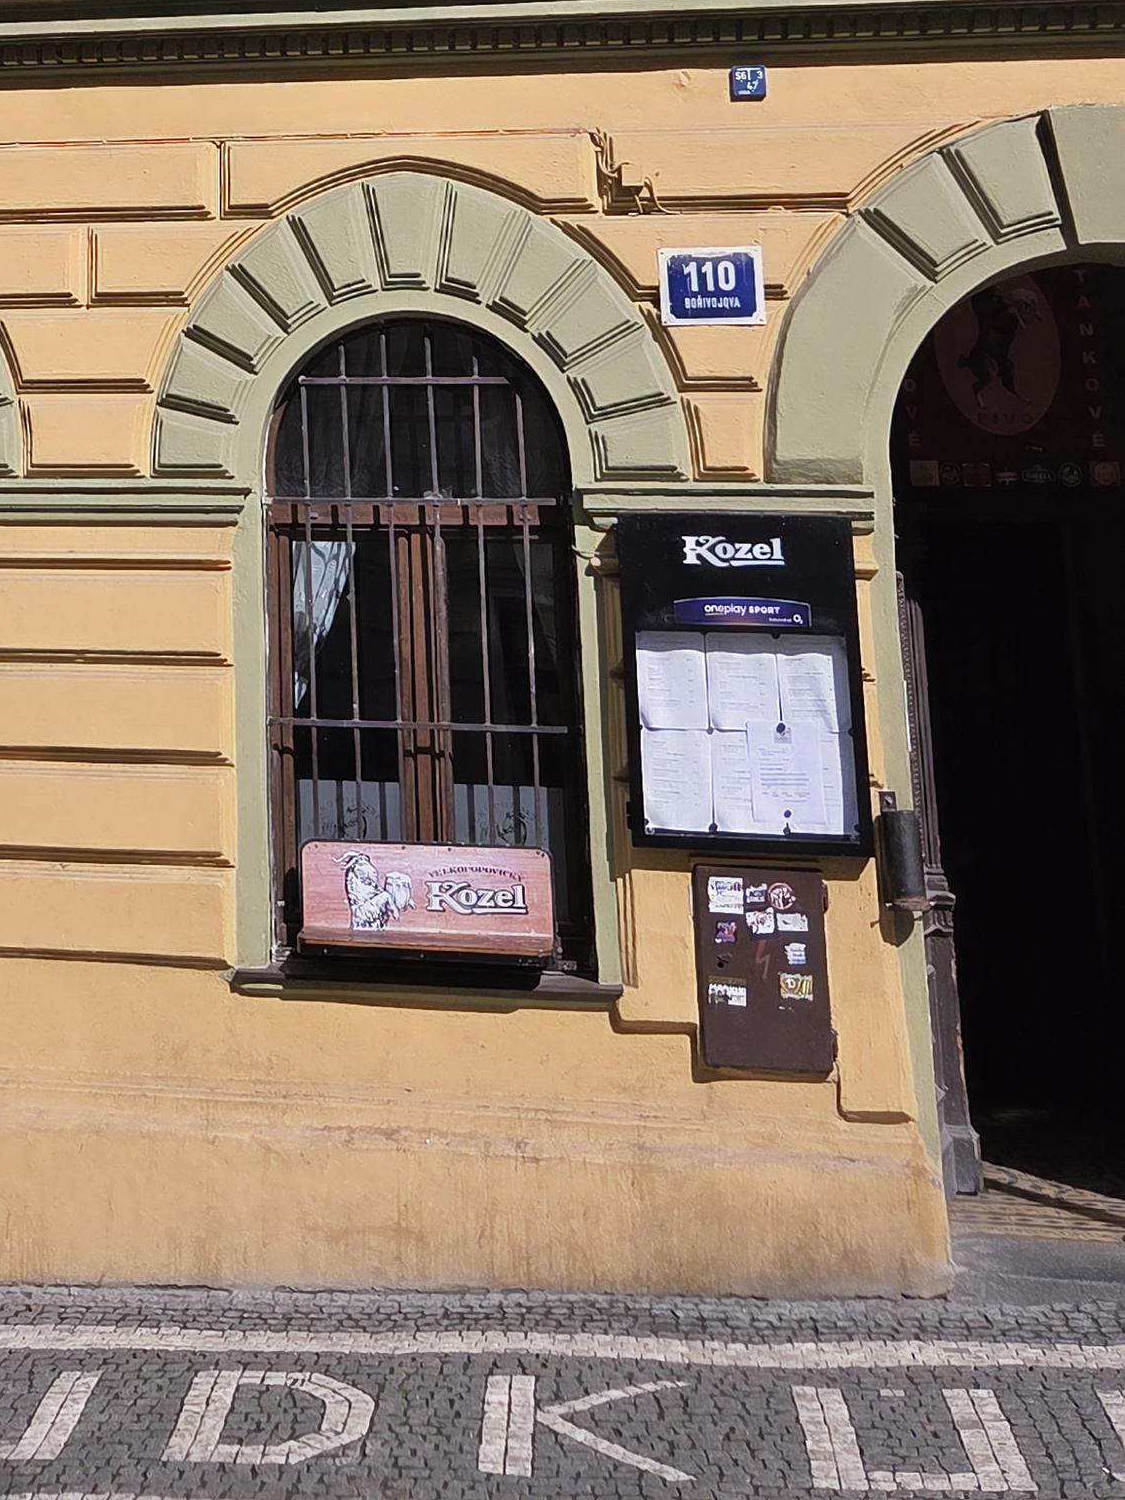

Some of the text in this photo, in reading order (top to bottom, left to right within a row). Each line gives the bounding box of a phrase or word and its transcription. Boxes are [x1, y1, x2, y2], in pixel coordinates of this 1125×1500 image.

[681, 260, 737, 292] 110
[681, 534, 786, 568] Kozel
[704, 603, 781, 616] oneplay SPORT
[424, 880, 529, 916] Kozel
